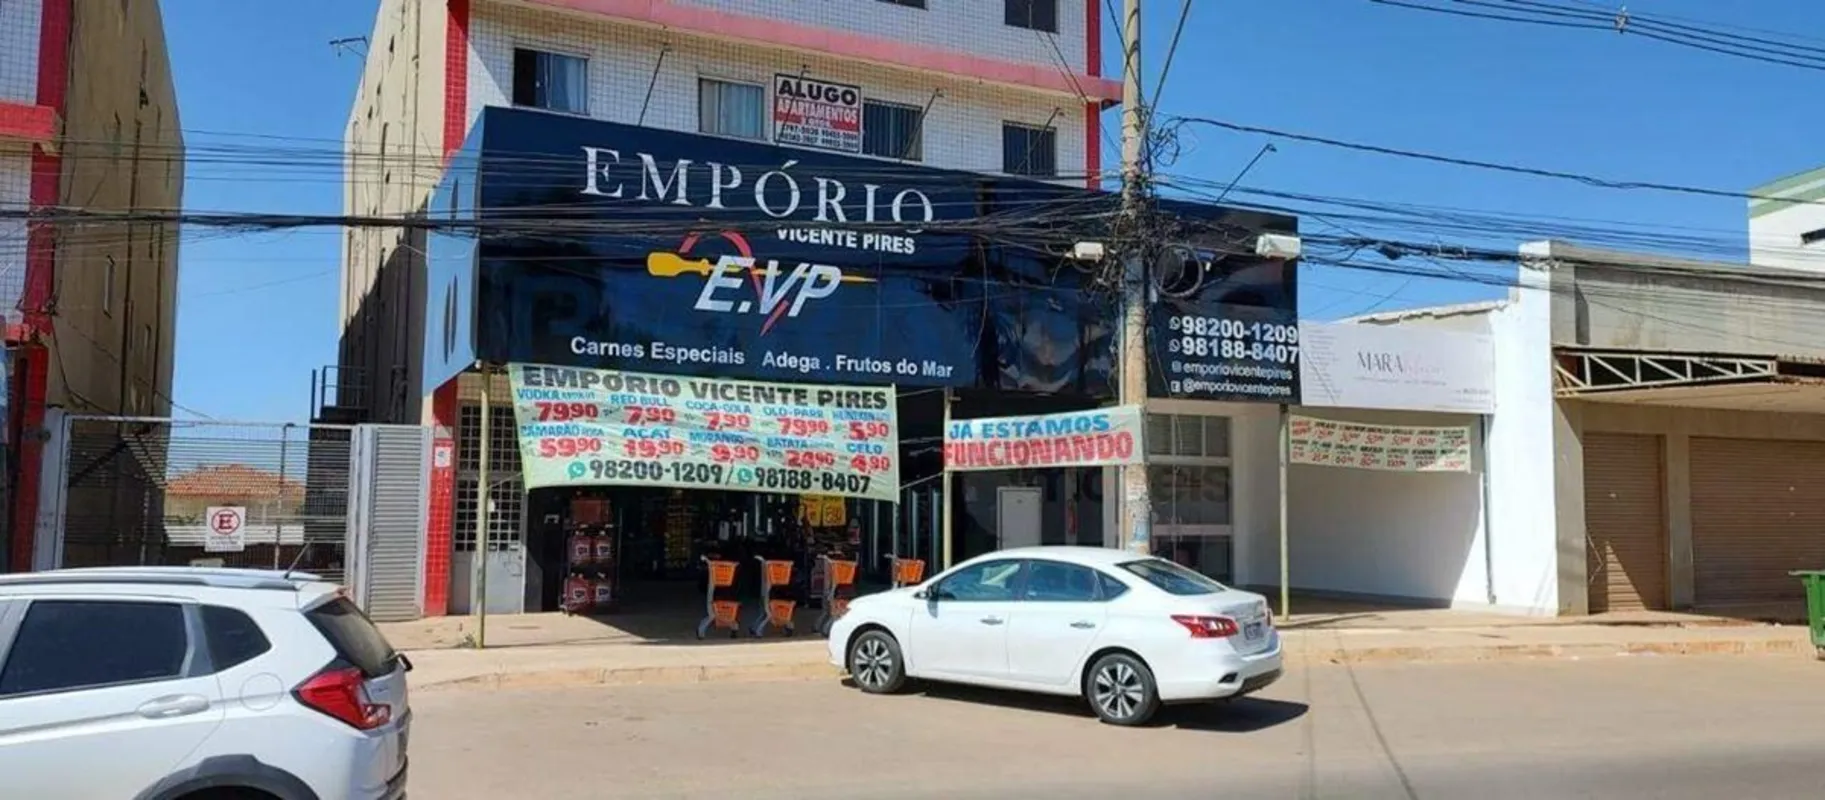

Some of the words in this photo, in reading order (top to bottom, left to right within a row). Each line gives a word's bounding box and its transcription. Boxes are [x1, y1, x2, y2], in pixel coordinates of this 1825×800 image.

[779, 80, 857, 105] ALUGO
[777, 98, 857, 124] APARTAMENTOS
[580, 146, 935, 234] EMPÓRIO
[777, 229, 857, 249] VICENTE
[863, 233, 915, 254] PIRES
[1182, 316, 1298, 344] 98200-1209
[571, 337, 644, 358] Carnes
[651, 342, 745, 365] Especiais
[762, 351, 820, 373] Adega
[836, 355, 891, 374] Frutos
[896, 357, 918, 376] do
[922, 361, 953, 378] Mar
[1182, 336, 1298, 363] 98188-8407
[517, 388, 560, 400] VODKA
[523, 365, 681, 397] EMPÓRIO
[690, 382, 808, 406] VICENTE
[818, 390, 888, 409] PIRES
[610, 394, 637, 406] RED
[640, 396, 674, 407] BULL
[982, 413, 1111, 438] ESTAMOS
[942, 430, 1134, 468] FUNCIONANDO
[589, 460, 723, 484] 98200-1209
[755, 467, 871, 494] 98188-8407
